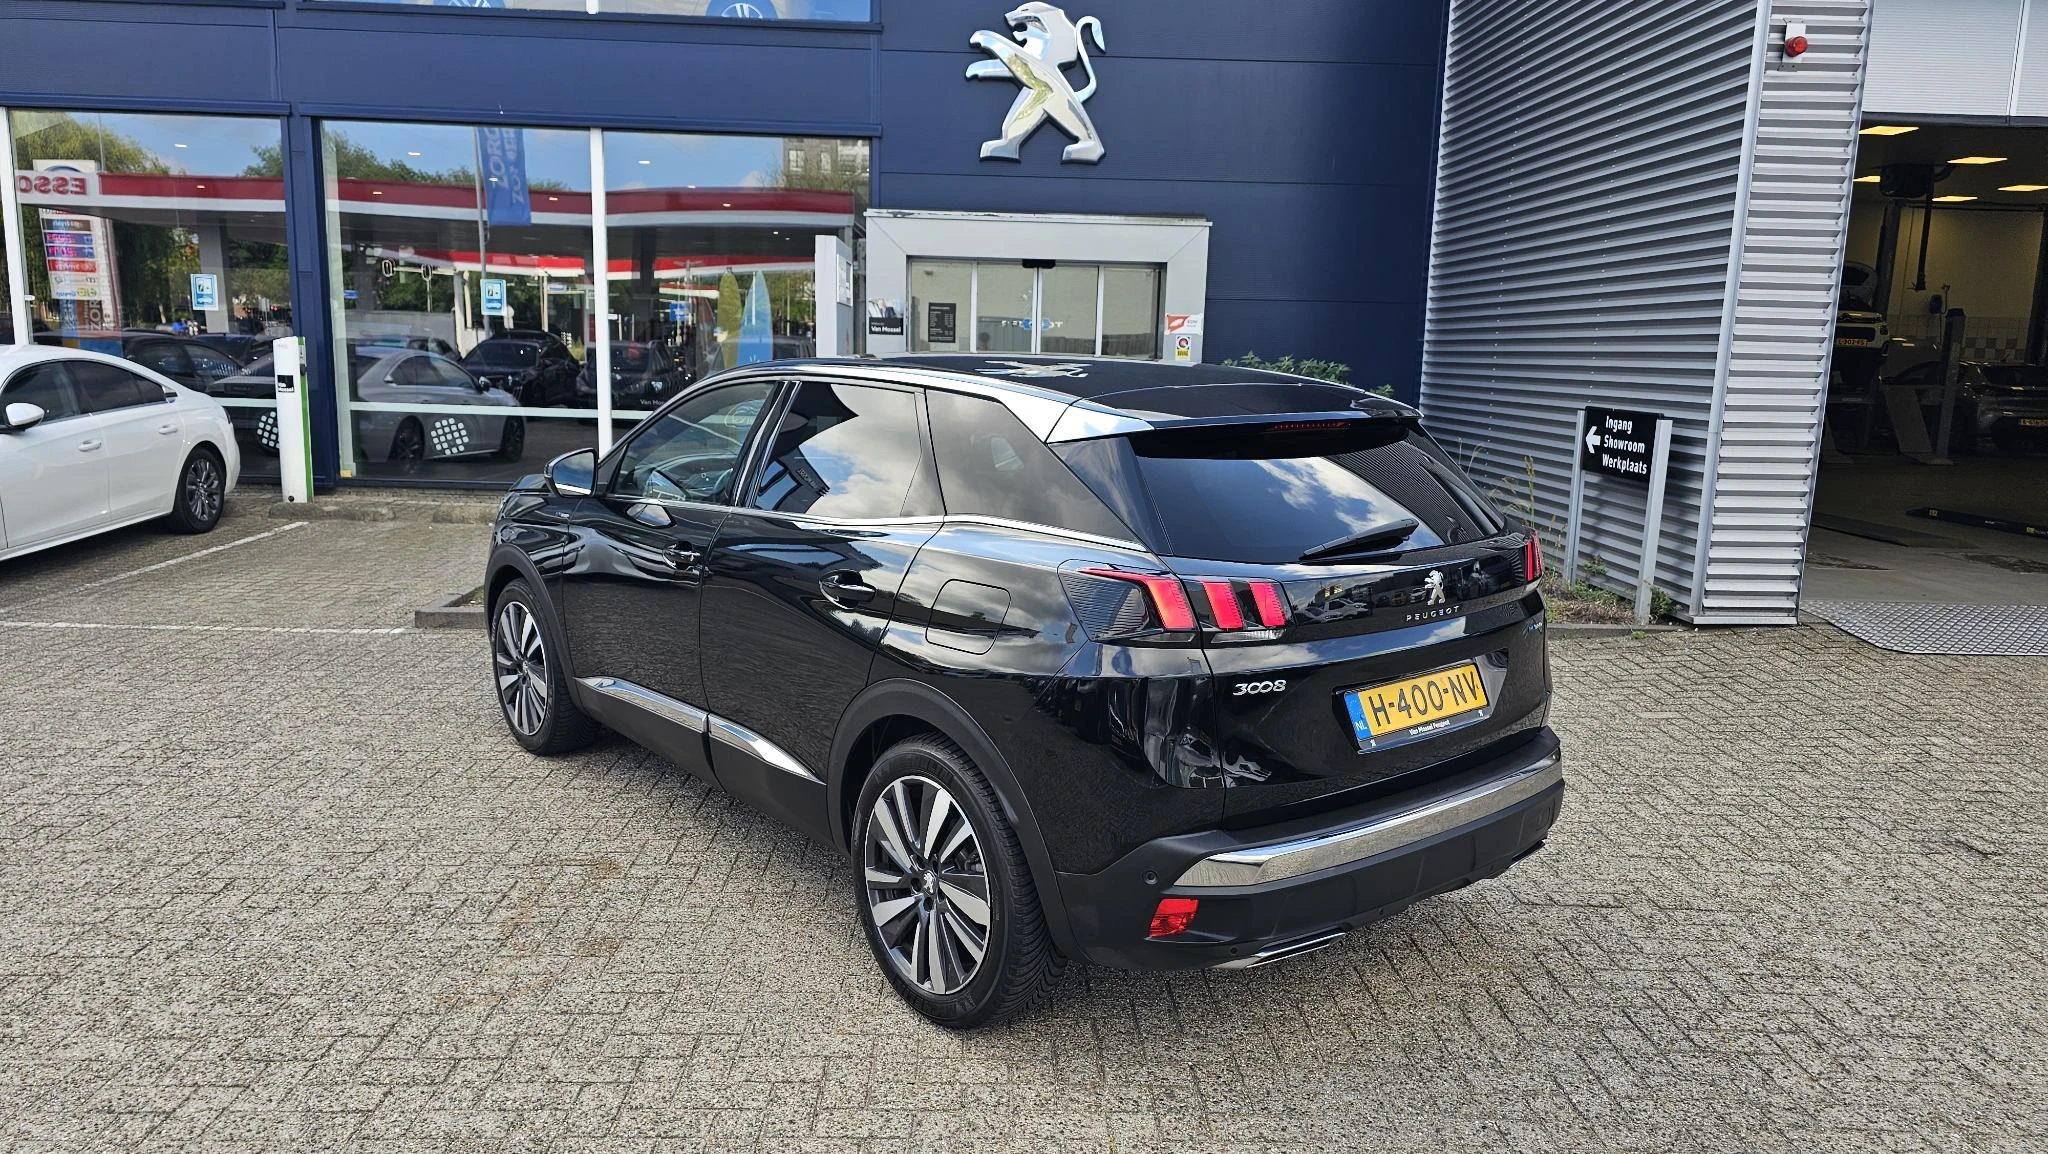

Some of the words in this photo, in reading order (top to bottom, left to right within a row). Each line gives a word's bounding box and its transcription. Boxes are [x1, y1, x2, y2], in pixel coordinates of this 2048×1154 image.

[1605, 415, 1633, 435] Ingang
[1603, 434, 1645, 454] Showroom
[1602, 453, 1648, 475] Werkplaats
[1406, 605, 1460, 621] PEUGEOT
[1232, 679, 1287, 696] 3008
[1367, 670, 1479, 727] H-400-NV
[1354, 720, 1368, 731] NL
